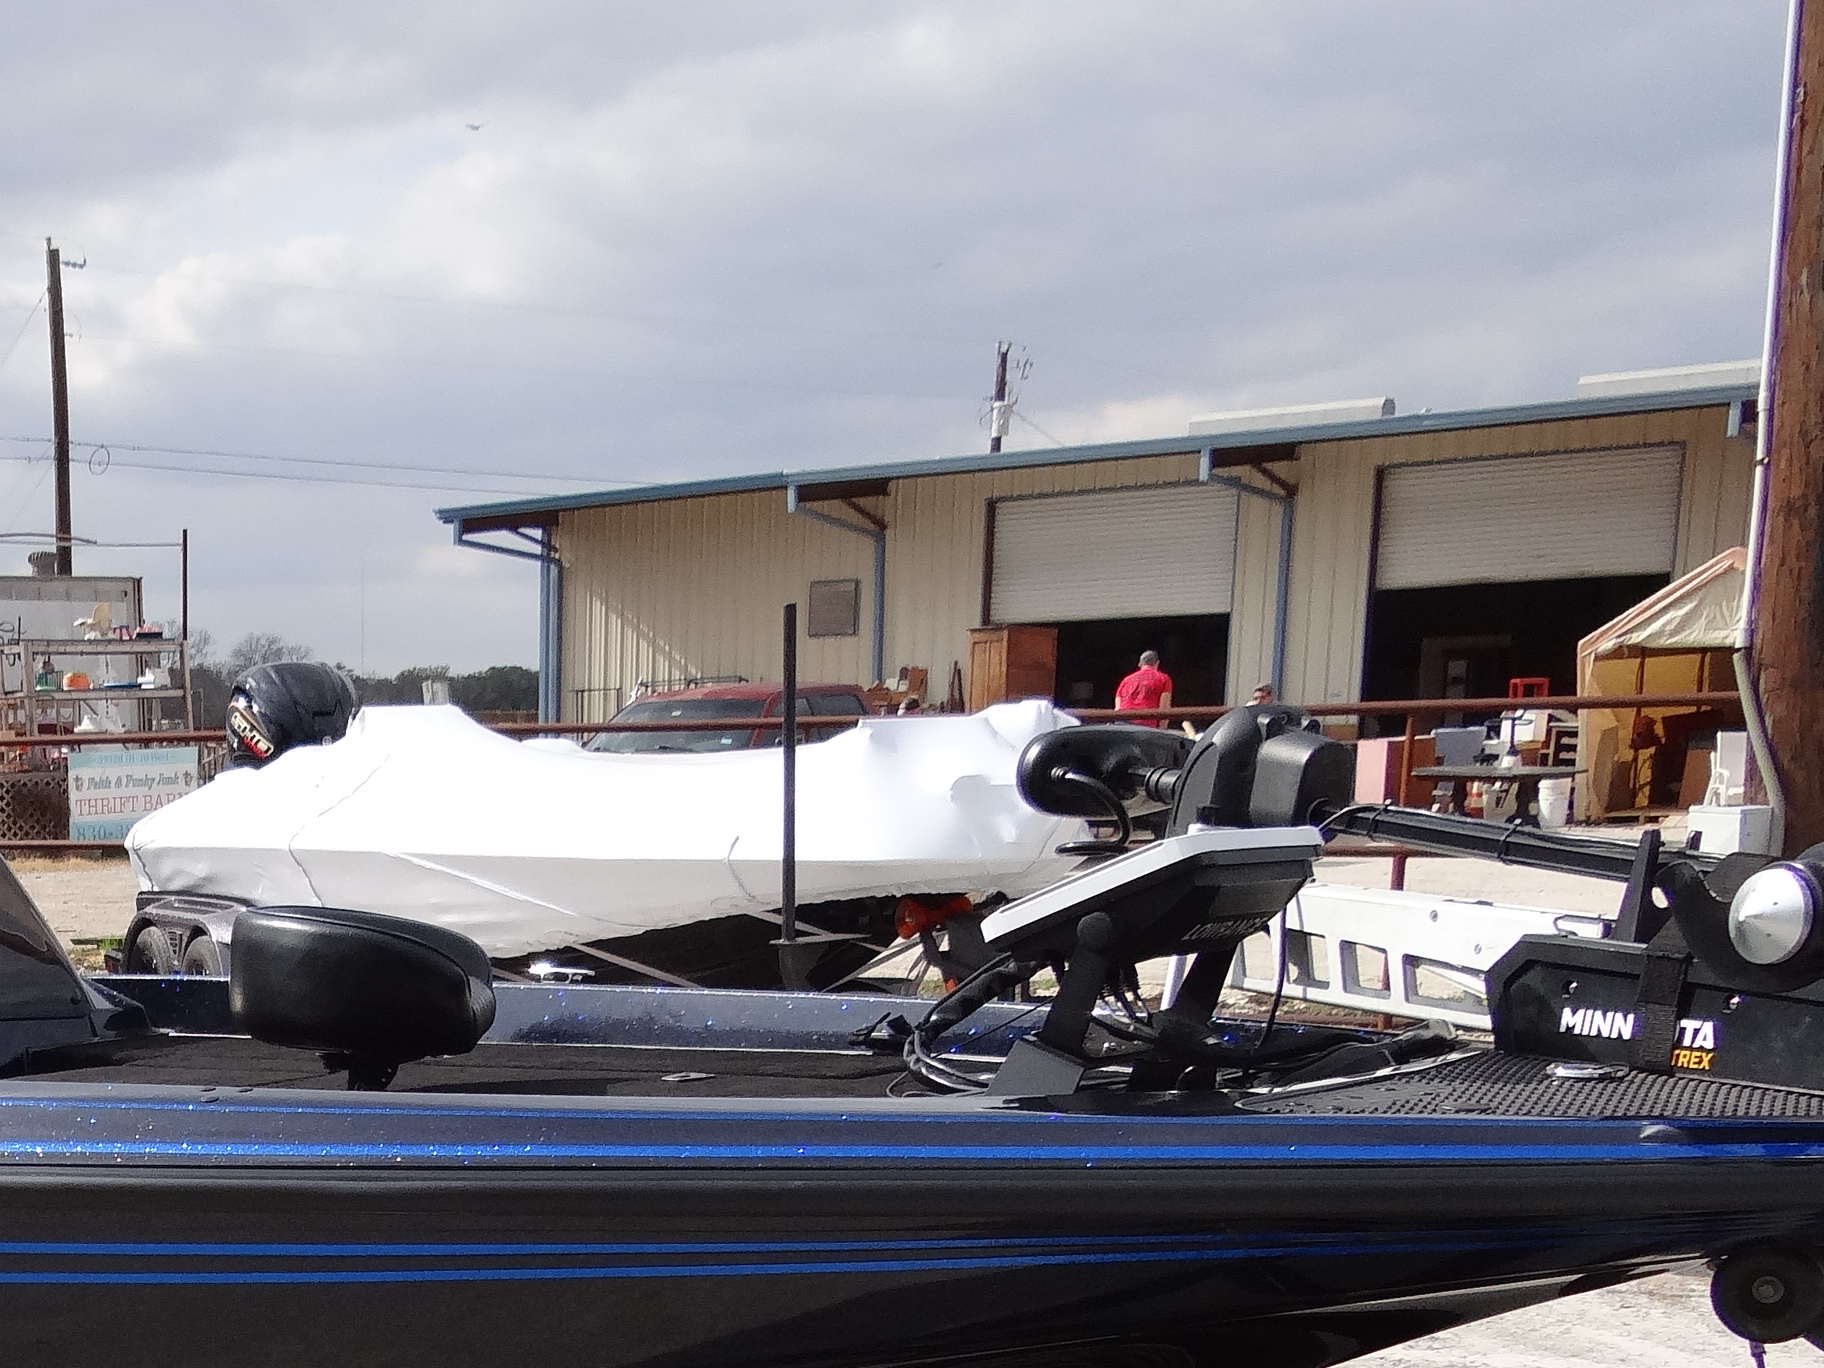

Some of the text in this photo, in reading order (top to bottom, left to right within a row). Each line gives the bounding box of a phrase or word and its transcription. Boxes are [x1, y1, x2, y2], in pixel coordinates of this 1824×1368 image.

[75, 792, 192, 817] THRIFT BAR
[1559, 1007, 1714, 1050] MINN TA
[1670, 1050, 1715, 1071] TREX
